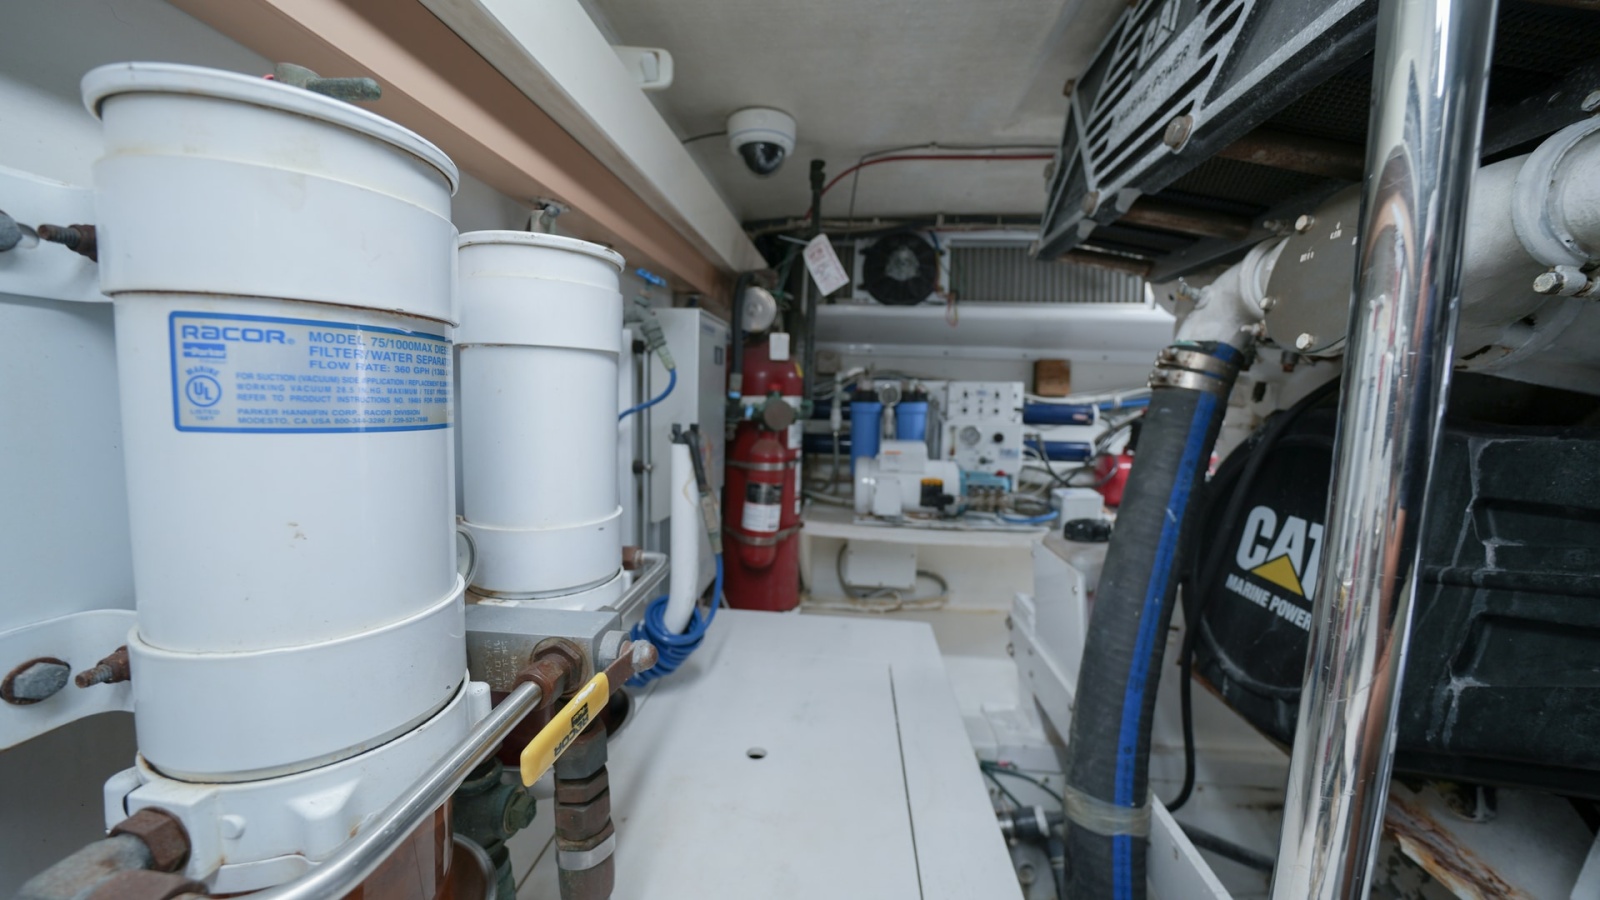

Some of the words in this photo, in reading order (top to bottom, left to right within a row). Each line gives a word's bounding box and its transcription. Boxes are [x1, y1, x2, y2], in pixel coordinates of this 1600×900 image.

[1151, 43, 1190, 93] POWER
[309, 331, 366, 346] MODEL
[371, 337, 432, 354] 75/1000MAX
[309, 346, 414, 363] FILTER/WATER
[309, 360, 349, 370] FLOW
[355, 362, 391, 373] RATE:
[394, 365, 411, 374] 360
[413, 366, 430, 375] GPH
[256, 373, 297, 381] SUCTION
[298, 374, 340, 384] (VACUUM)
[342, 376, 359, 384] SIDE
[193, 381, 212, 400] UL
[236, 383, 285, 391] WORKING
[290, 385, 332, 393] VACUUM
[236, 393, 266, 401] REFER
[271, 394, 285, 402] TO
[289, 395, 332, 403] PRODUCT
[1236, 505, 1324, 601] CAT
[1225, 573, 1271, 608] MARINE
[1268, 595, 1312, 632] POWER
